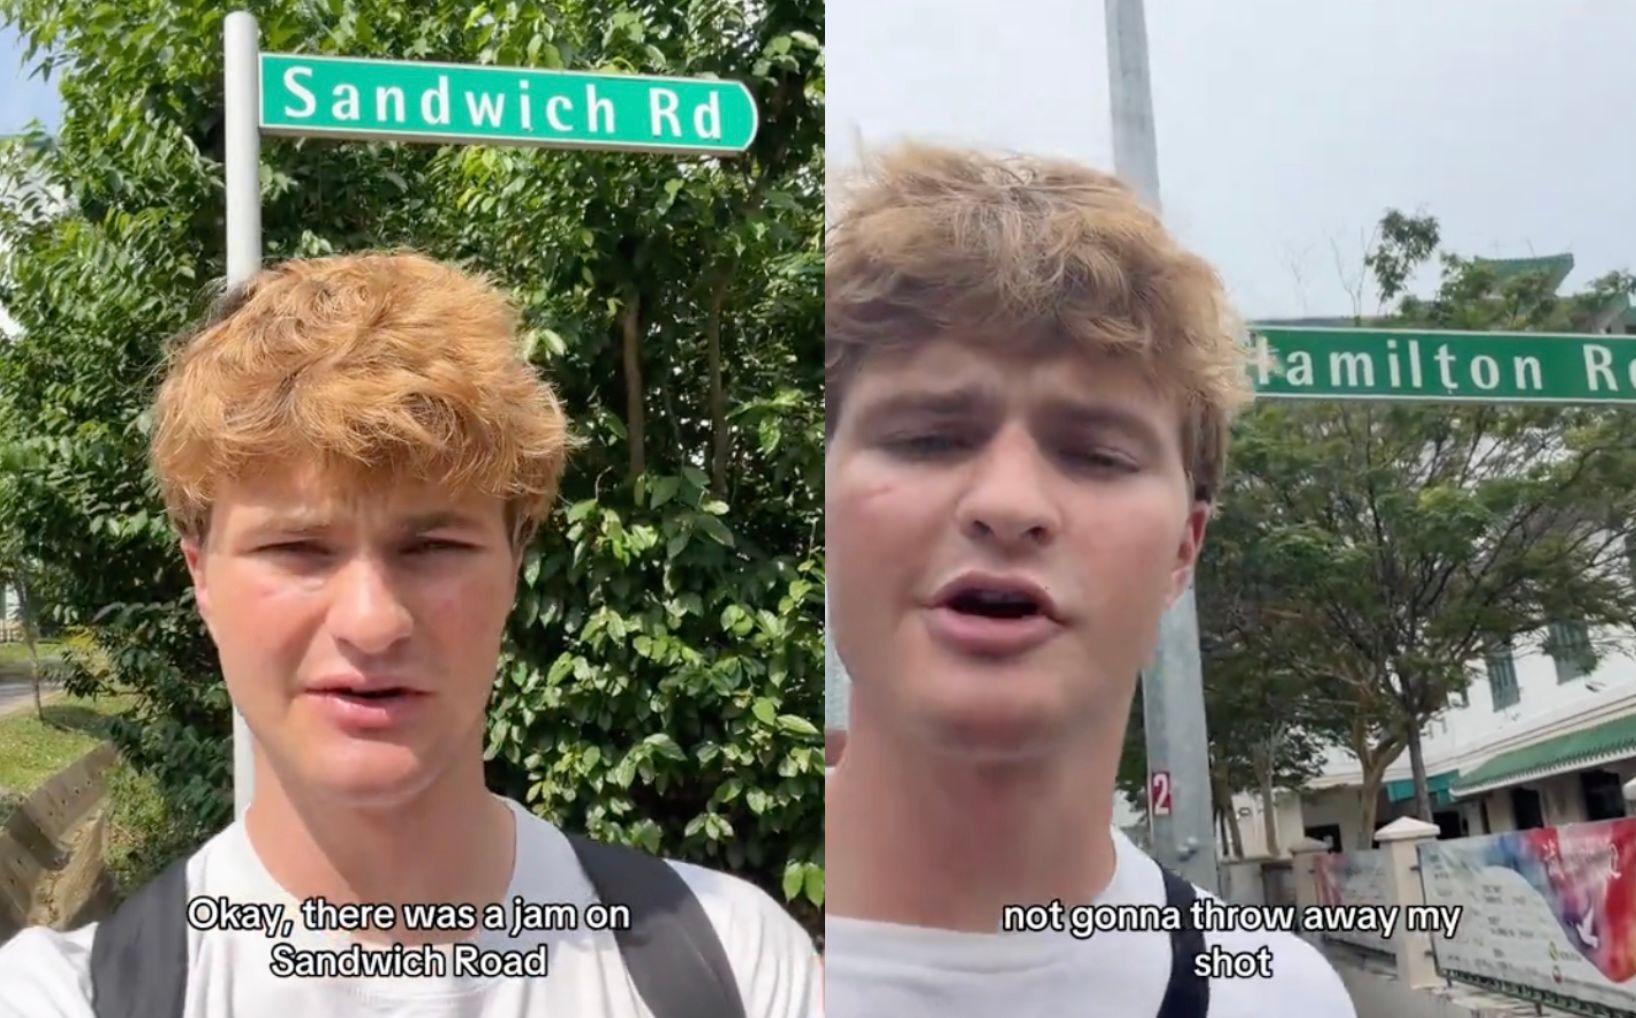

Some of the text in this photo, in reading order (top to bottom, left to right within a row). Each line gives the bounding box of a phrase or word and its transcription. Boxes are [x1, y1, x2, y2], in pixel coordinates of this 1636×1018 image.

[283, 66, 721, 140] Sandwich Rd
[1583, 344, 1636, 392] R
[1153, 773, 1170, 816] 2
